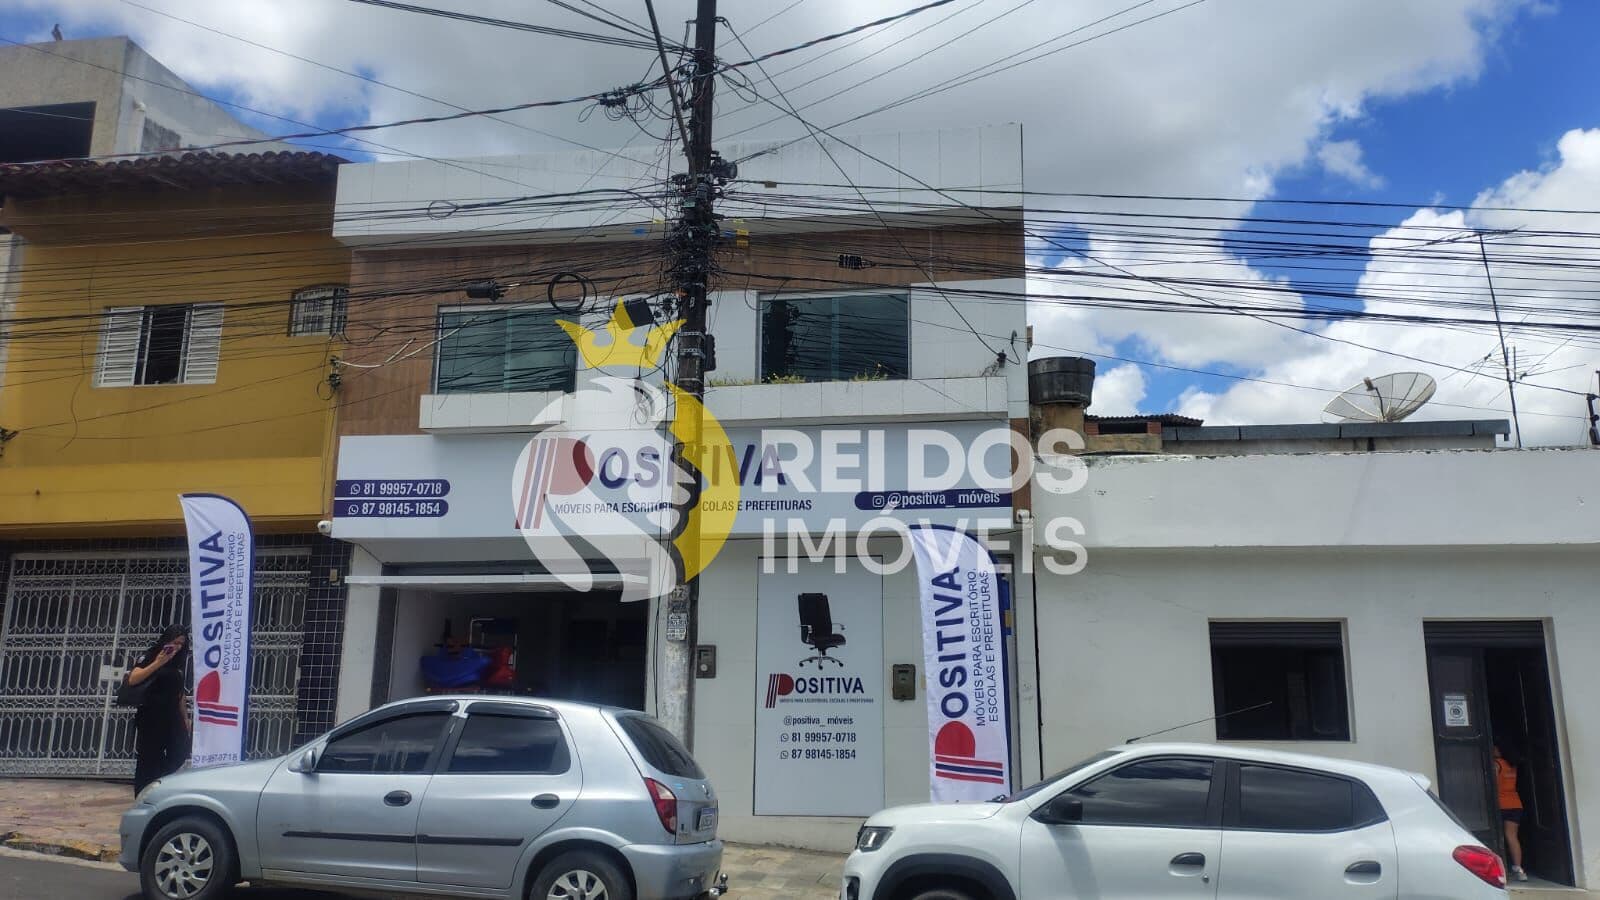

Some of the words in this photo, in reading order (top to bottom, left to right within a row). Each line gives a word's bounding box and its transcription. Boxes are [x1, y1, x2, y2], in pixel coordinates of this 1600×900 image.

[364, 482, 375, 495] 81
[380, 482, 442, 495] 99957-0718
[514, 437, 787, 529] POSIIVA
[362, 502, 375, 515] 87
[379, 502, 441, 515] 98145-1854
[554, 501, 593, 513] MÓVEIS
[594, 503, 619, 513] PARA
[702, 500, 735, 512] COLAS
[737, 501, 742, 511] E
[745, 499, 813, 511] PREFEITURAS
[979, 571, 994, 651] PREFEITURAS
[972, 644, 983, 676] PARA
[985, 653, 995, 662] E
[765, 673, 865, 708] POSITIVA
[986, 665, 999, 722] ESCOLAS
[973, 679, 986, 727] MÓVEIS
[791, 732, 801, 743] 81
[804, 732, 857, 743] 99957-0718
[791, 749, 802, 759] 87
[805, 749, 856, 759] 98145-1854
